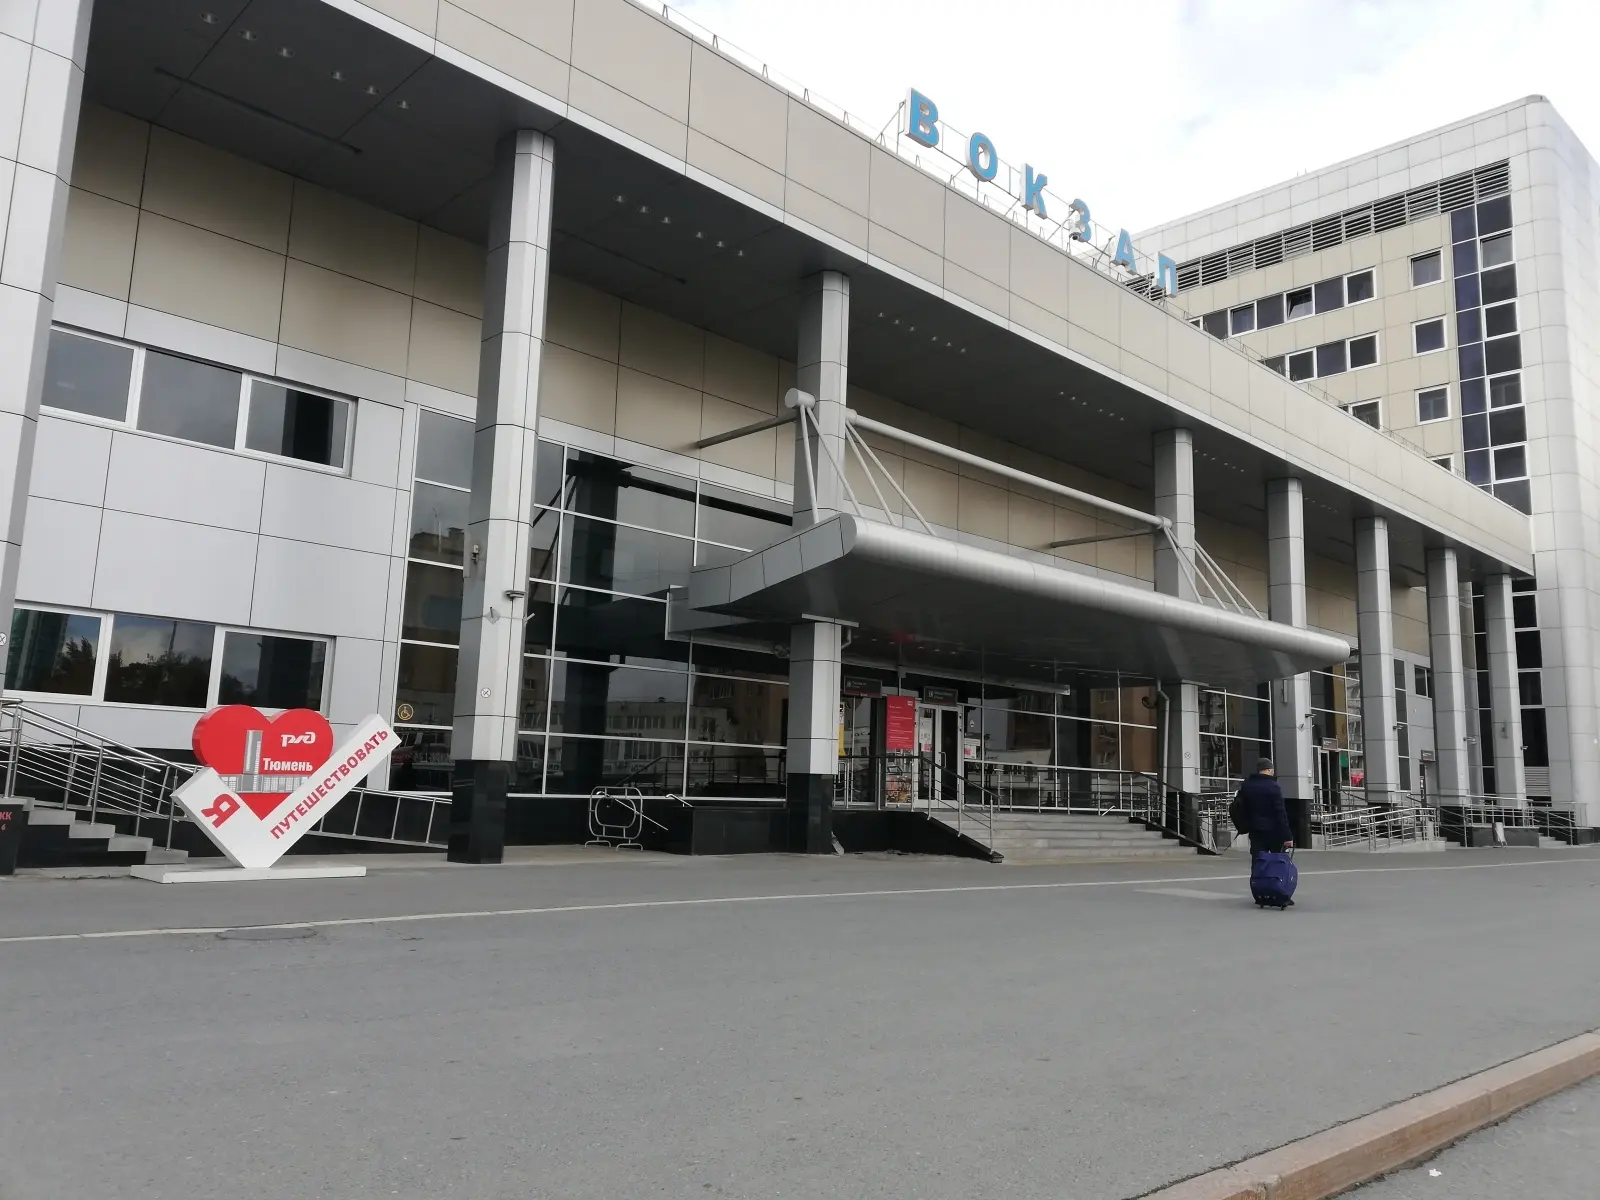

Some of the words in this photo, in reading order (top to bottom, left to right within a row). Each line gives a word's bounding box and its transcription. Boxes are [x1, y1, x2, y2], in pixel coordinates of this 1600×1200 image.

[905, 87, 1178, 298] ВОКЗАЛ
[262, 757, 313, 772] Тюмень
[269, 729, 389, 840] ПУТЕШЕСТВОВАТЬ
[201, 793, 241, 829] Я
